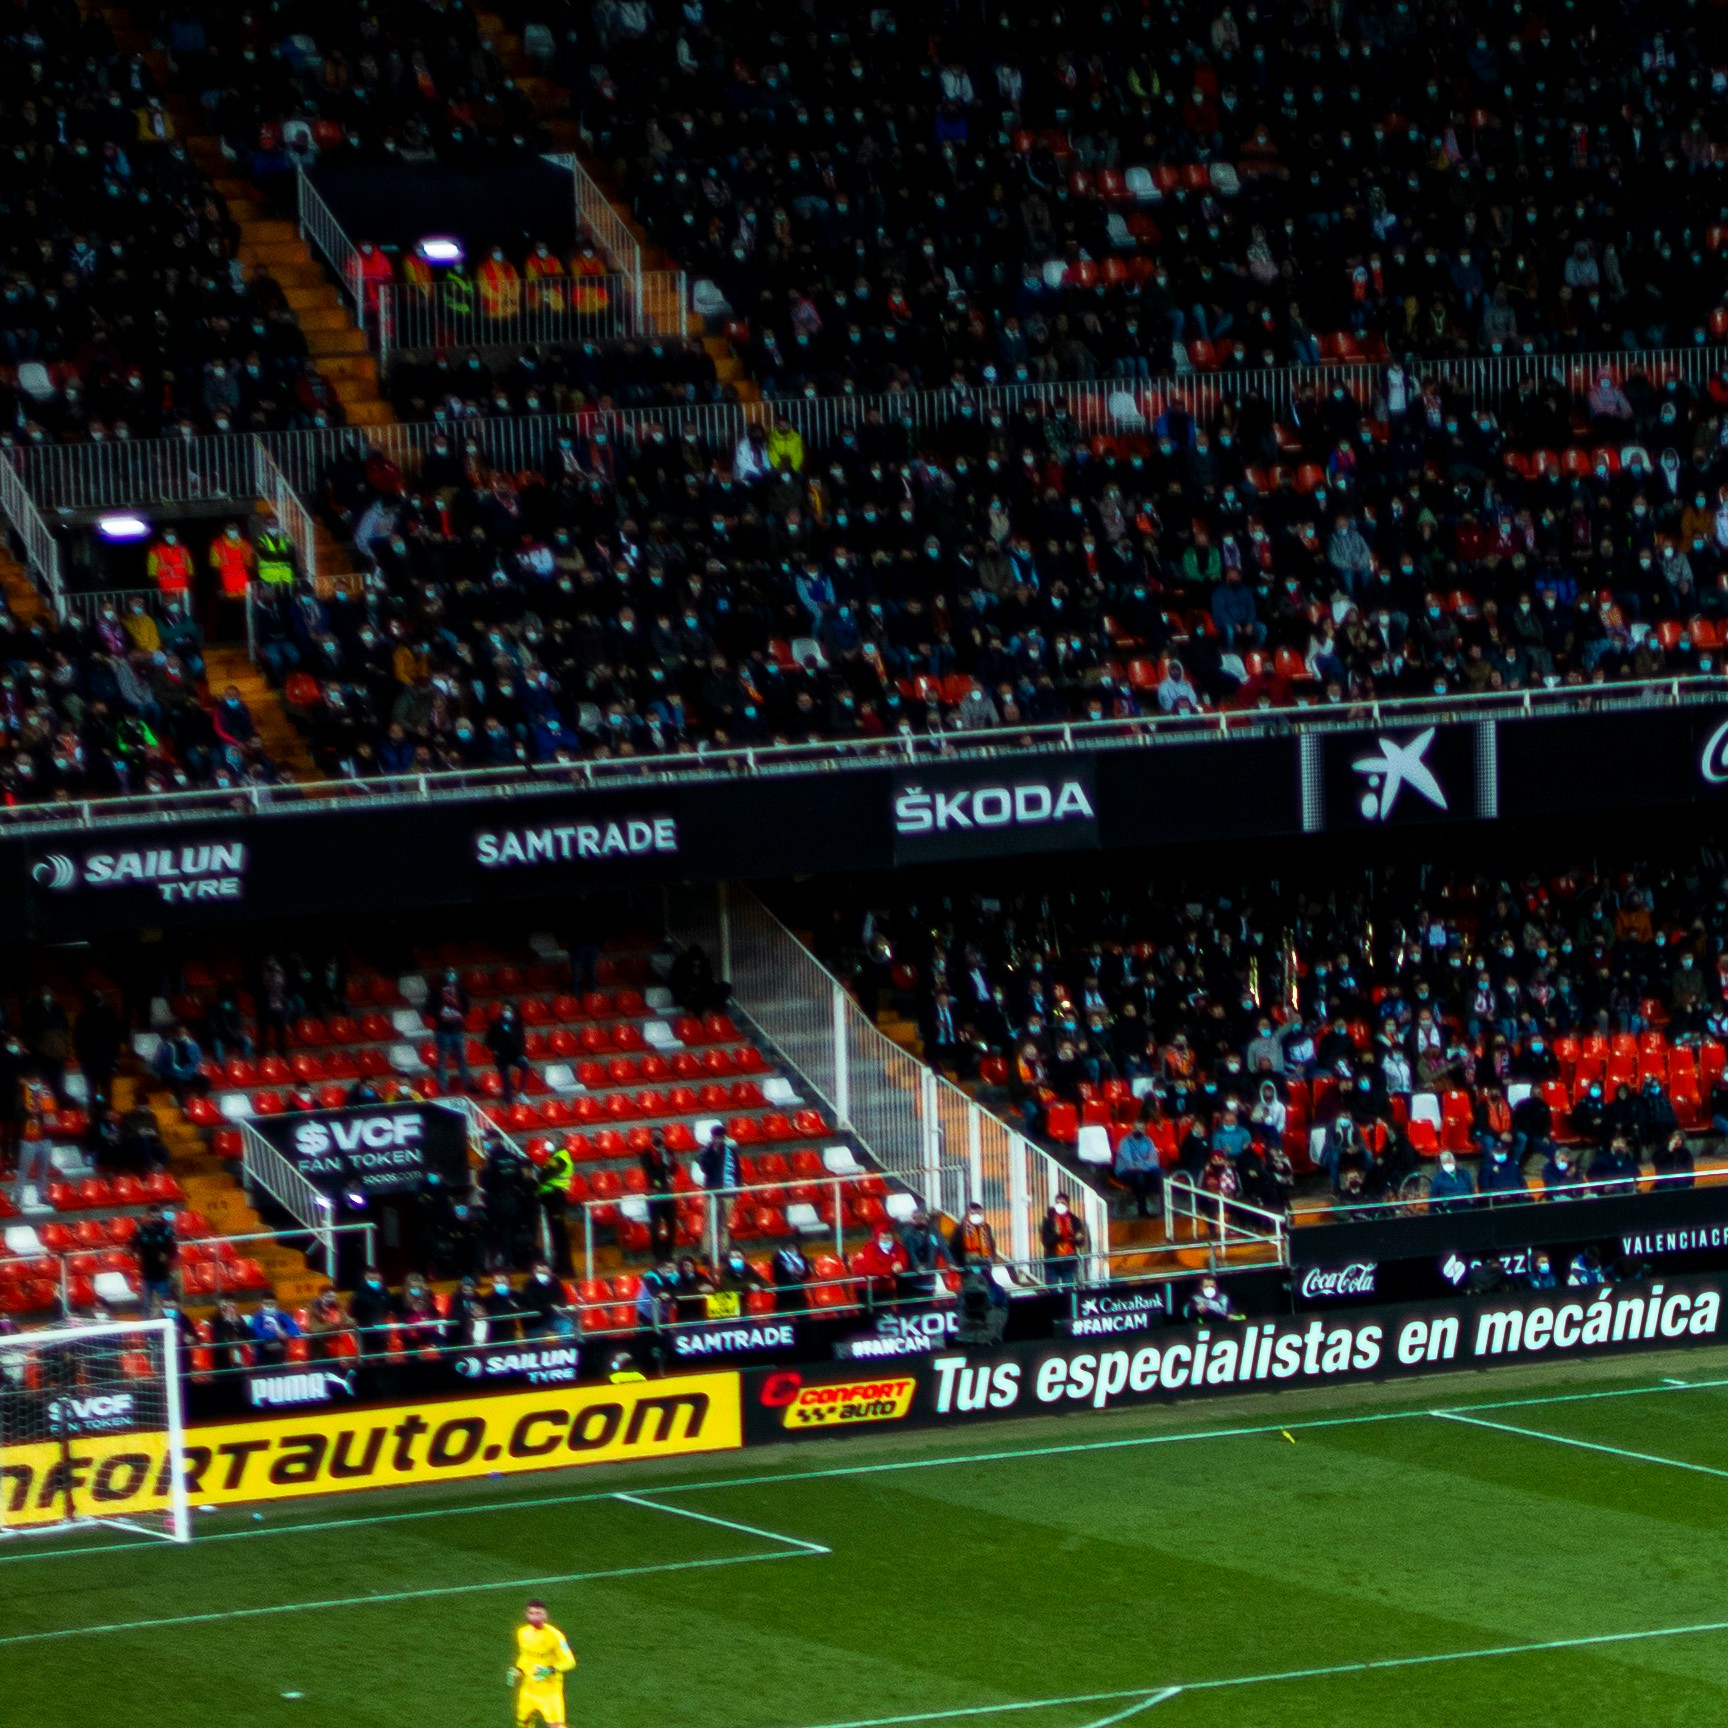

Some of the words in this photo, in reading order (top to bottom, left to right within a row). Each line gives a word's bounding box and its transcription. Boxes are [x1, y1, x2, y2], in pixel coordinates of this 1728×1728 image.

[895, 781, 1094, 833] ŠKODA
[475, 818, 678, 866] SAMTRADE
[84, 842, 245, 882] SAILUN
[158, 877, 241, 902] TYRE
[295, 1113, 423, 1156] $VCF
[297, 1157, 343, 1173] FAN
[348, 1149, 423, 1168] TOKEN
[1099, 1295, 1164, 1315] CaixaBank
[876, 1312, 959, 1340] ŠKOD
[1071, 1313, 1148, 1336] #FANCAM
[676, 1325, 795, 1355] SAMTRADE
[851, 1335, 932, 1359] #FANCAM
[932, 1356, 1021, 1415] Tus
[1036, 1322, 1382, 1409] especialistas
[1398, 1316, 1459, 1364] en
[1474, 1284, 1721, 1356] mecánica
[485, 1348, 578, 1374] SAILUN
[528, 1368, 576, 1384] TYRE
[251, 1372, 327, 1407] PUMA
[84, 1414, 135, 1430] TOKEN
[839, 1400, 898, 1420] auto
